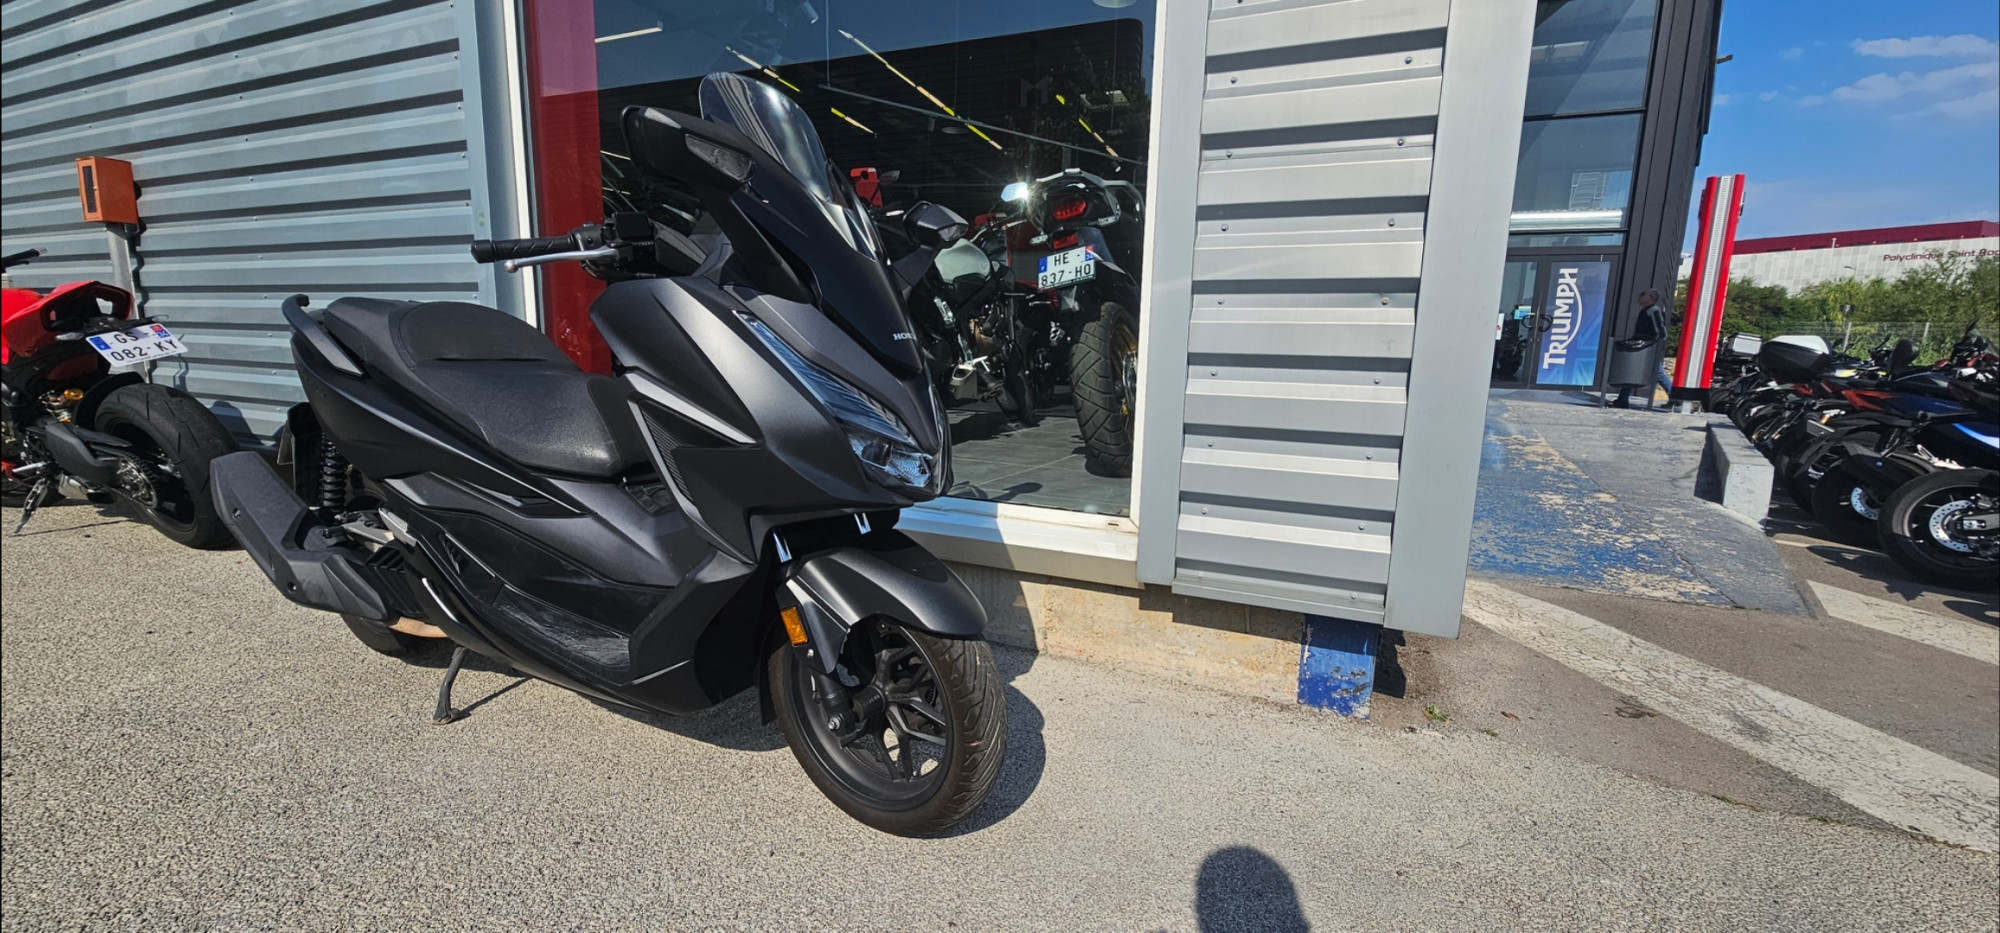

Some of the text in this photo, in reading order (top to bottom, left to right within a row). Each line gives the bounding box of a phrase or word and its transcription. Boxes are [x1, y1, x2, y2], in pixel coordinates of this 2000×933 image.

[1053, 252, 1070, 267] HE
[1543, 267, 1582, 370] TRIUMPH
[113, 331, 139, 344] GS
[110, 339, 178, 361] 082-KY
